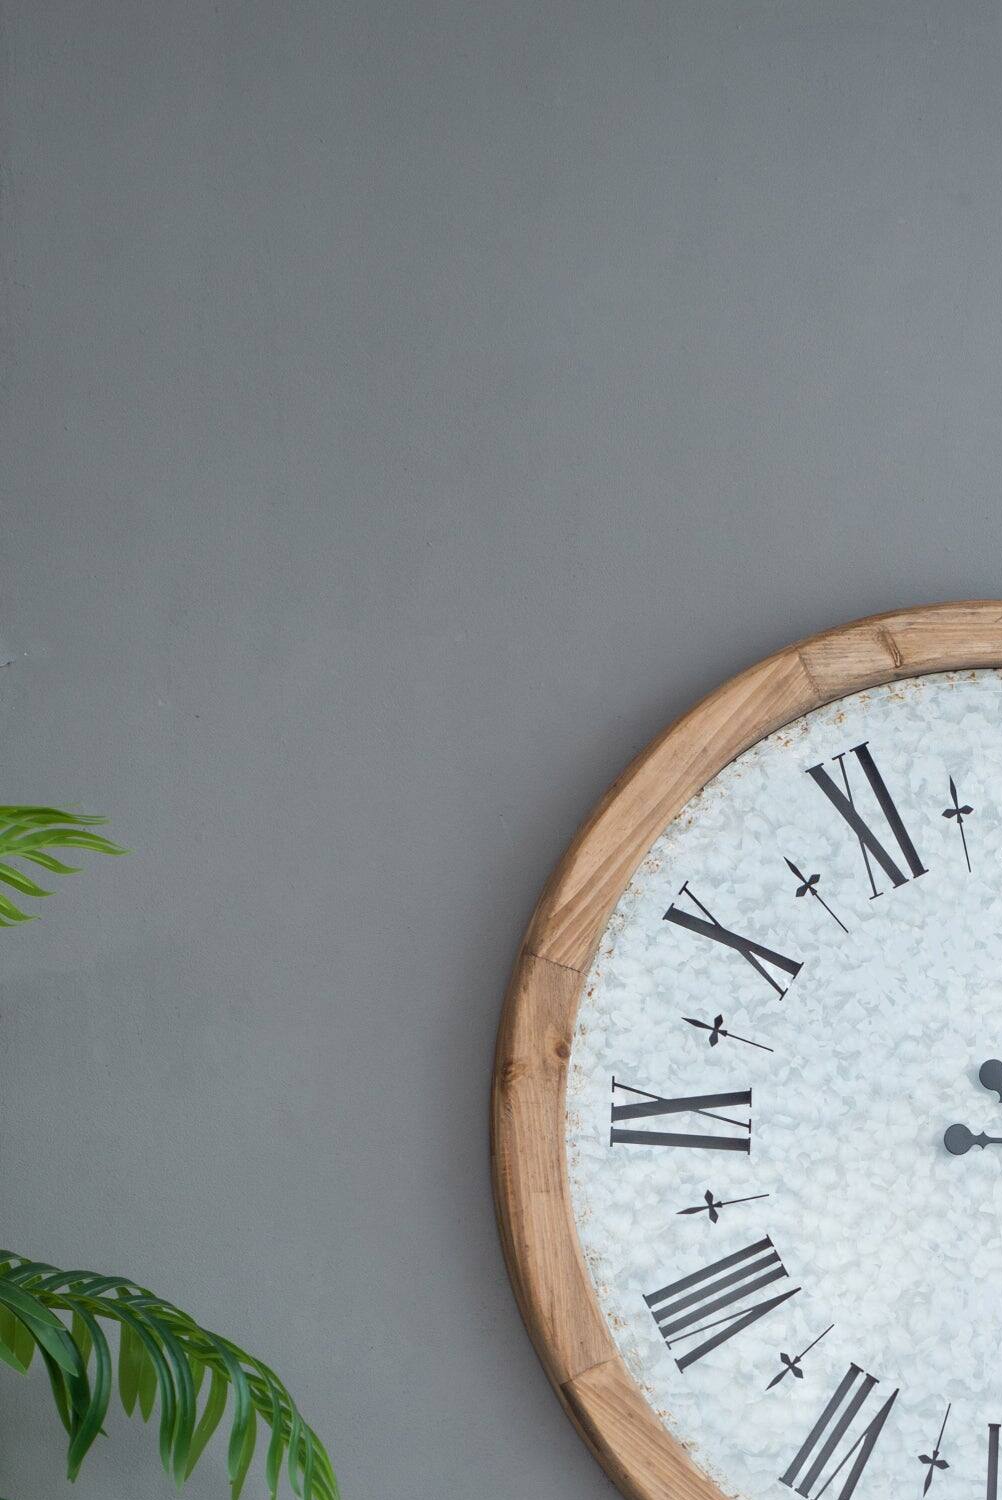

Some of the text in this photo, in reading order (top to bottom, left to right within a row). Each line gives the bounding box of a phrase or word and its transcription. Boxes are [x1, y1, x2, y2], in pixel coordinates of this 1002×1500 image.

[807, 741, 929, 899] XI
[663, 881, 803, 999] X
[609, 1075, 753, 1156] IX
[642, 1236, 801, 1372] VIII
